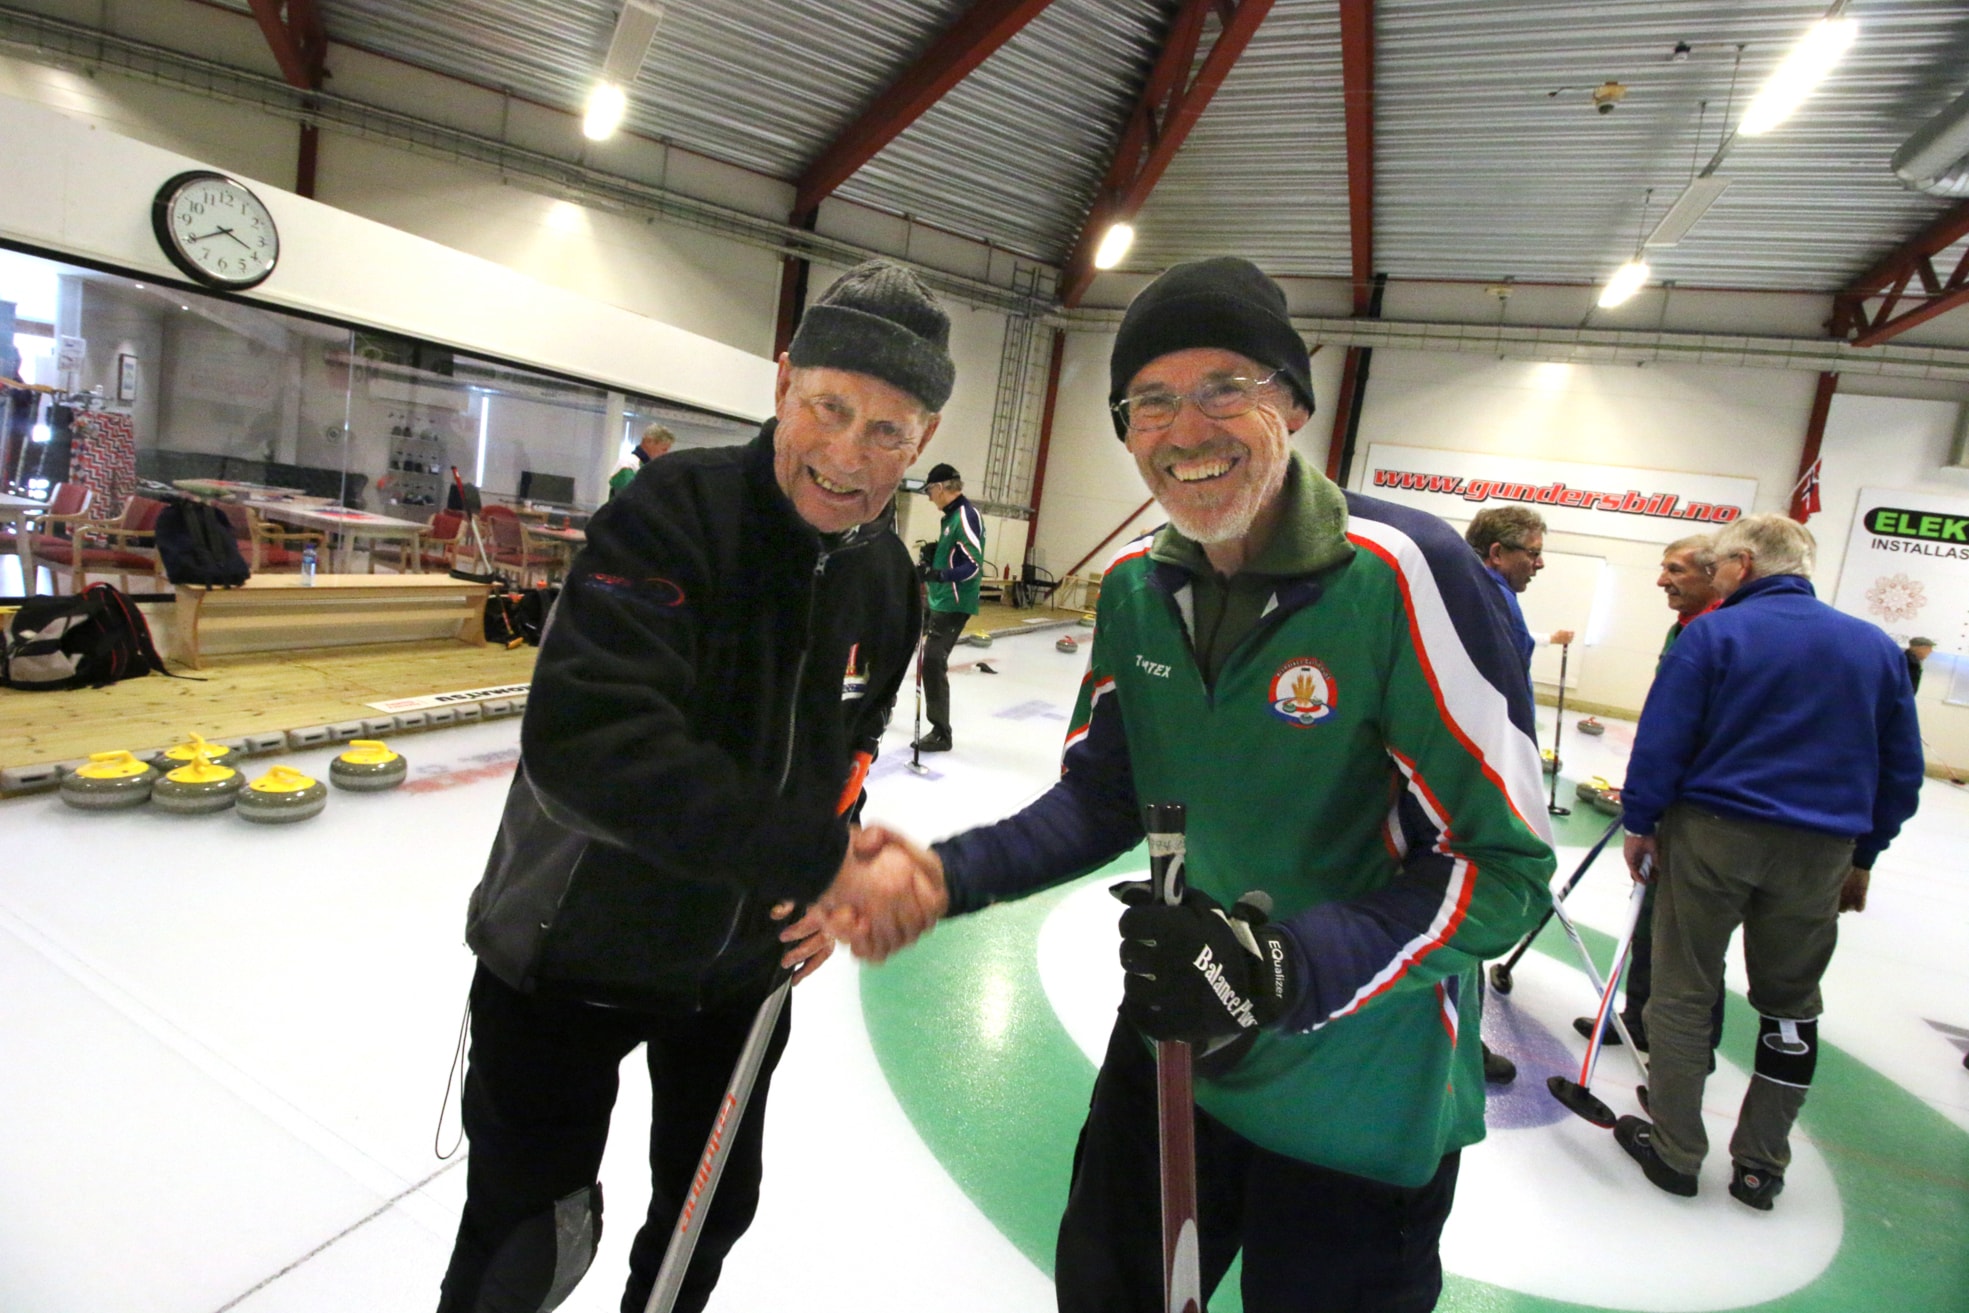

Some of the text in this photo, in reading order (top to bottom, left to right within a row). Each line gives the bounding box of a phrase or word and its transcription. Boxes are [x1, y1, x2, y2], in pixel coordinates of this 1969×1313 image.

[203, 192, 215, 206] 11
[219, 192, 234, 208] 12
[189, 201, 205, 215] 10
[181, 213, 193, 225] 9
[250, 217, 260, 229] 2
[201, 247, 211, 260] 7
[250, 251, 259, 262] 4
[217, 258, 228, 271] 6
[238, 258, 247, 271] 5
[1373, 468, 1742, 523] www.gundersbil.no
[1873, 510, 1969, 541] ELEK
[1871, 538, 1969, 561] INSTALLAS
[1268, 939, 1284, 999] EQualizer
